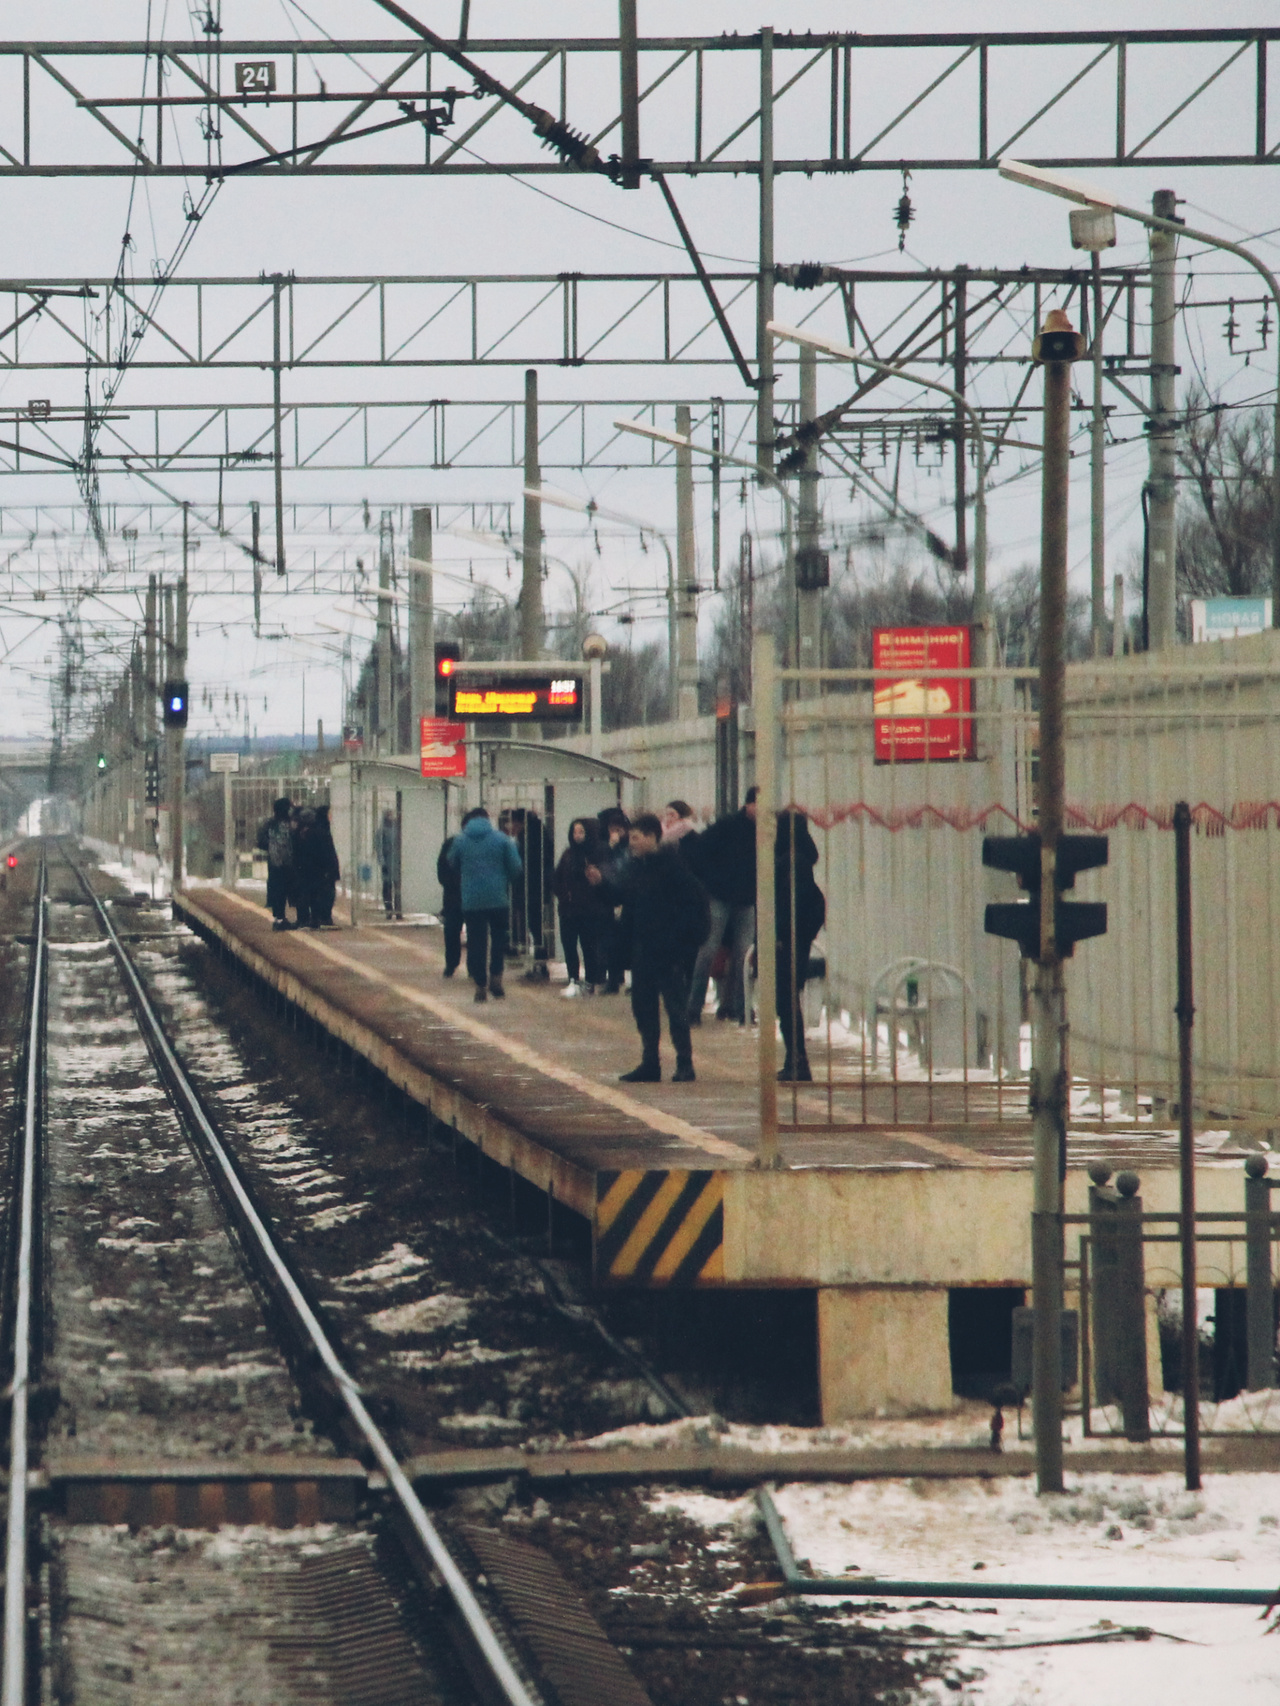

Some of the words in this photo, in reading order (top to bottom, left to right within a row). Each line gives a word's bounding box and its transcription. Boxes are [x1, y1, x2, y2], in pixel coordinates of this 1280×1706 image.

[243, 66, 269, 88] 24
[1210, 611, 1260, 624] НОВАЯ
[881, 725, 921, 734] Бдьте
